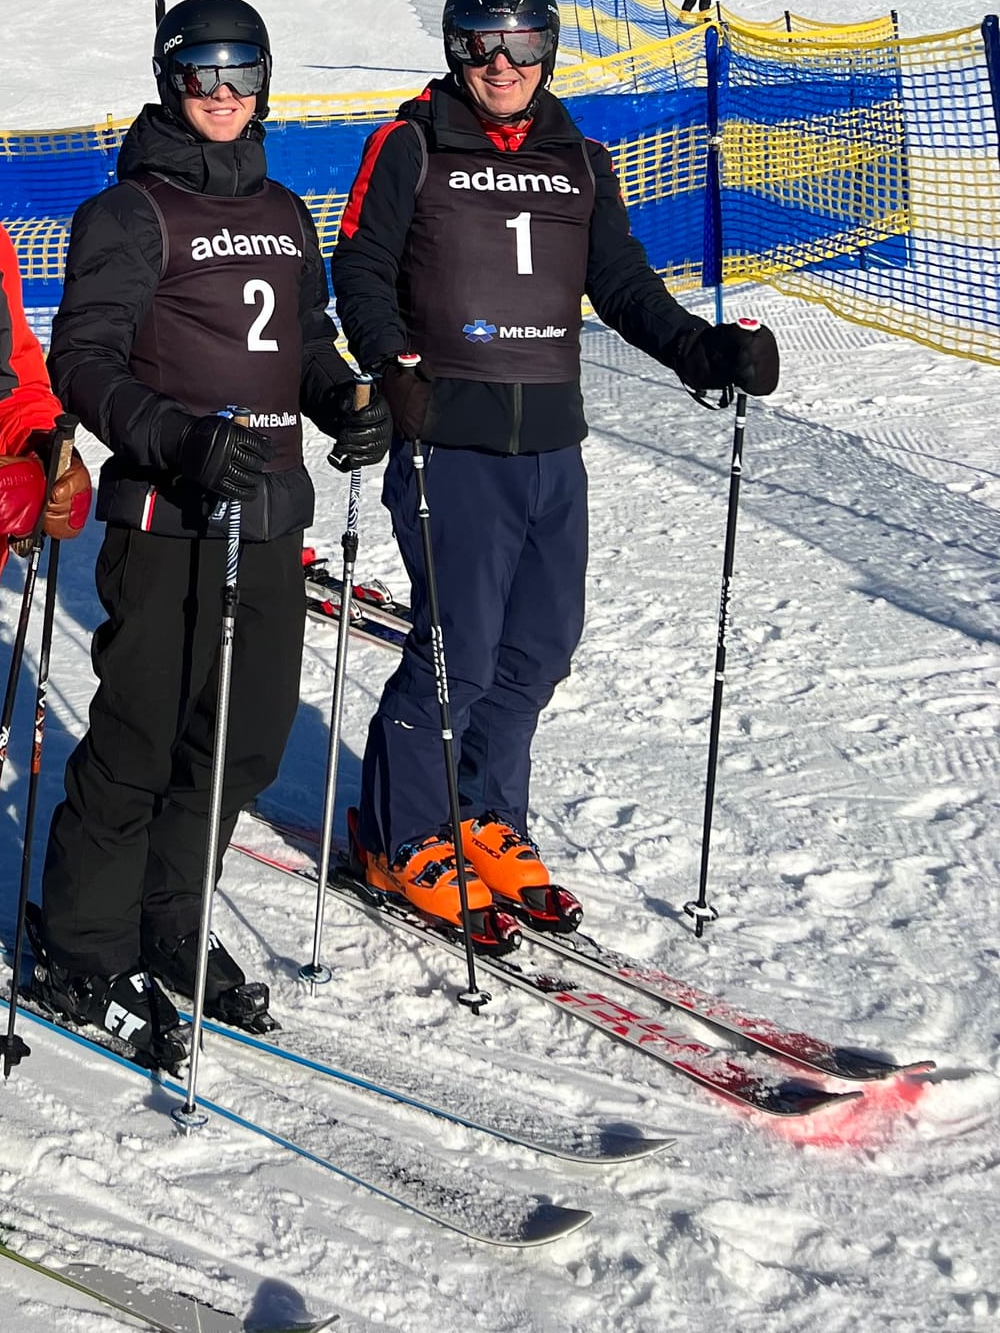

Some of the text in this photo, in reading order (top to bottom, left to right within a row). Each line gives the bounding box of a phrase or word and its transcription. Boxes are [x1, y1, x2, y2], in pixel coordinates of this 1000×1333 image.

[449, 167, 580, 194] adams.
[191, 228, 302, 261] adams.
[506, 212, 533, 274] 1
[243, 279, 279, 352] 2
[104, 1000, 147, 1042] FT
